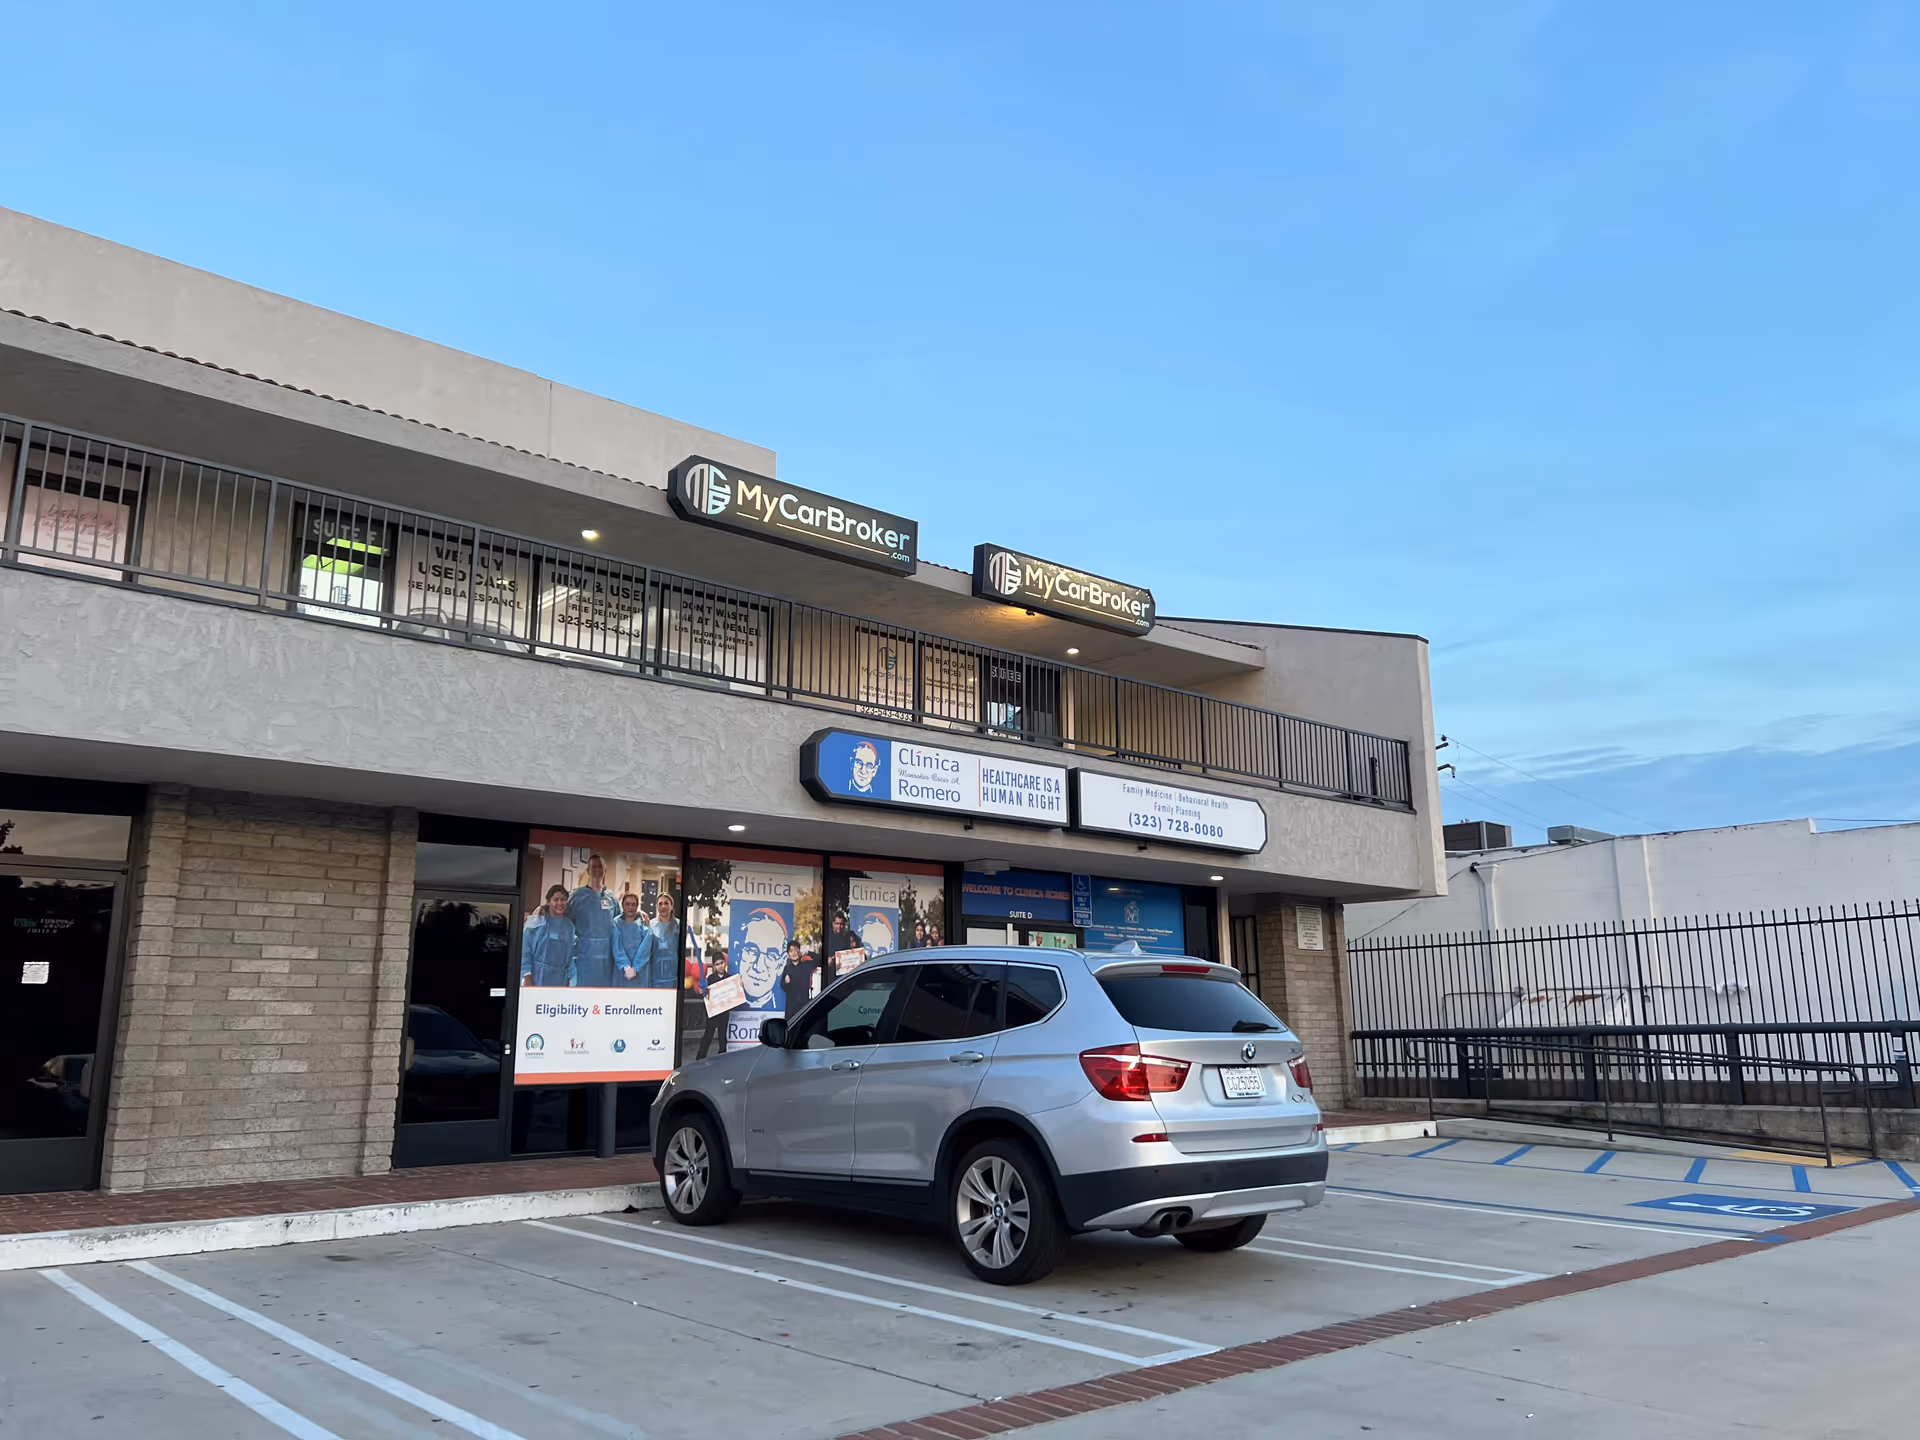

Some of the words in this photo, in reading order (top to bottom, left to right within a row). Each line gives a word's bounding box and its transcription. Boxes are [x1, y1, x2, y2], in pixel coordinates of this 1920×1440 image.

[737, 479, 911, 550] MyCarBroker
[313, 519, 360, 541] SUTE
[435, 546, 462, 563] WE
[890, 551, 910, 563] .com
[418, 562, 467, 582] USED
[475, 574, 519, 593] CARS
[408, 580, 423, 590] SE
[427, 583, 467, 599] HABLA
[1025, 564, 1150, 617] MyCarBroker
[593, 608, 633, 621] DELIVER
[683, 600, 712, 614] DONT
[558, 613, 641, 638] 323-543-4333
[1135, 618, 1150, 628] .com
[935, 657, 950, 666] BAT
[898, 748, 960, 772] Clínica
[982, 768, 1041, 791] HEALTHCARE
[1044, 778, 1052, 793] IS
[1054, 779, 1060, 793] A
[899, 779, 961, 803] Romero
[982, 787, 1022, 806] HUMAN
[1028, 793, 1061, 811] RIGHT
[1123, 783, 1143, 797] Family
[1145, 787, 1172, 800] Medicine
[1179, 793, 1209, 807] Behavioral
[1154, 802, 1174, 815] Family
[1176, 805, 1201, 820] Planning
[1128, 812, 1162, 832] (323)
[1167, 818, 1224, 838] 728-0080
[734, 875, 792, 897] Clínica
[851, 884, 897, 903] Clínica
[1009, 910, 1026, 919] SUITE
[1027, 911, 1033, 919] D
[535, 1003, 589, 1017] Eligibility
[592, 1004, 601, 1015] &
[604, 1004, 663, 1016] Enrollment
[728, 1023, 759, 1040] Rom
